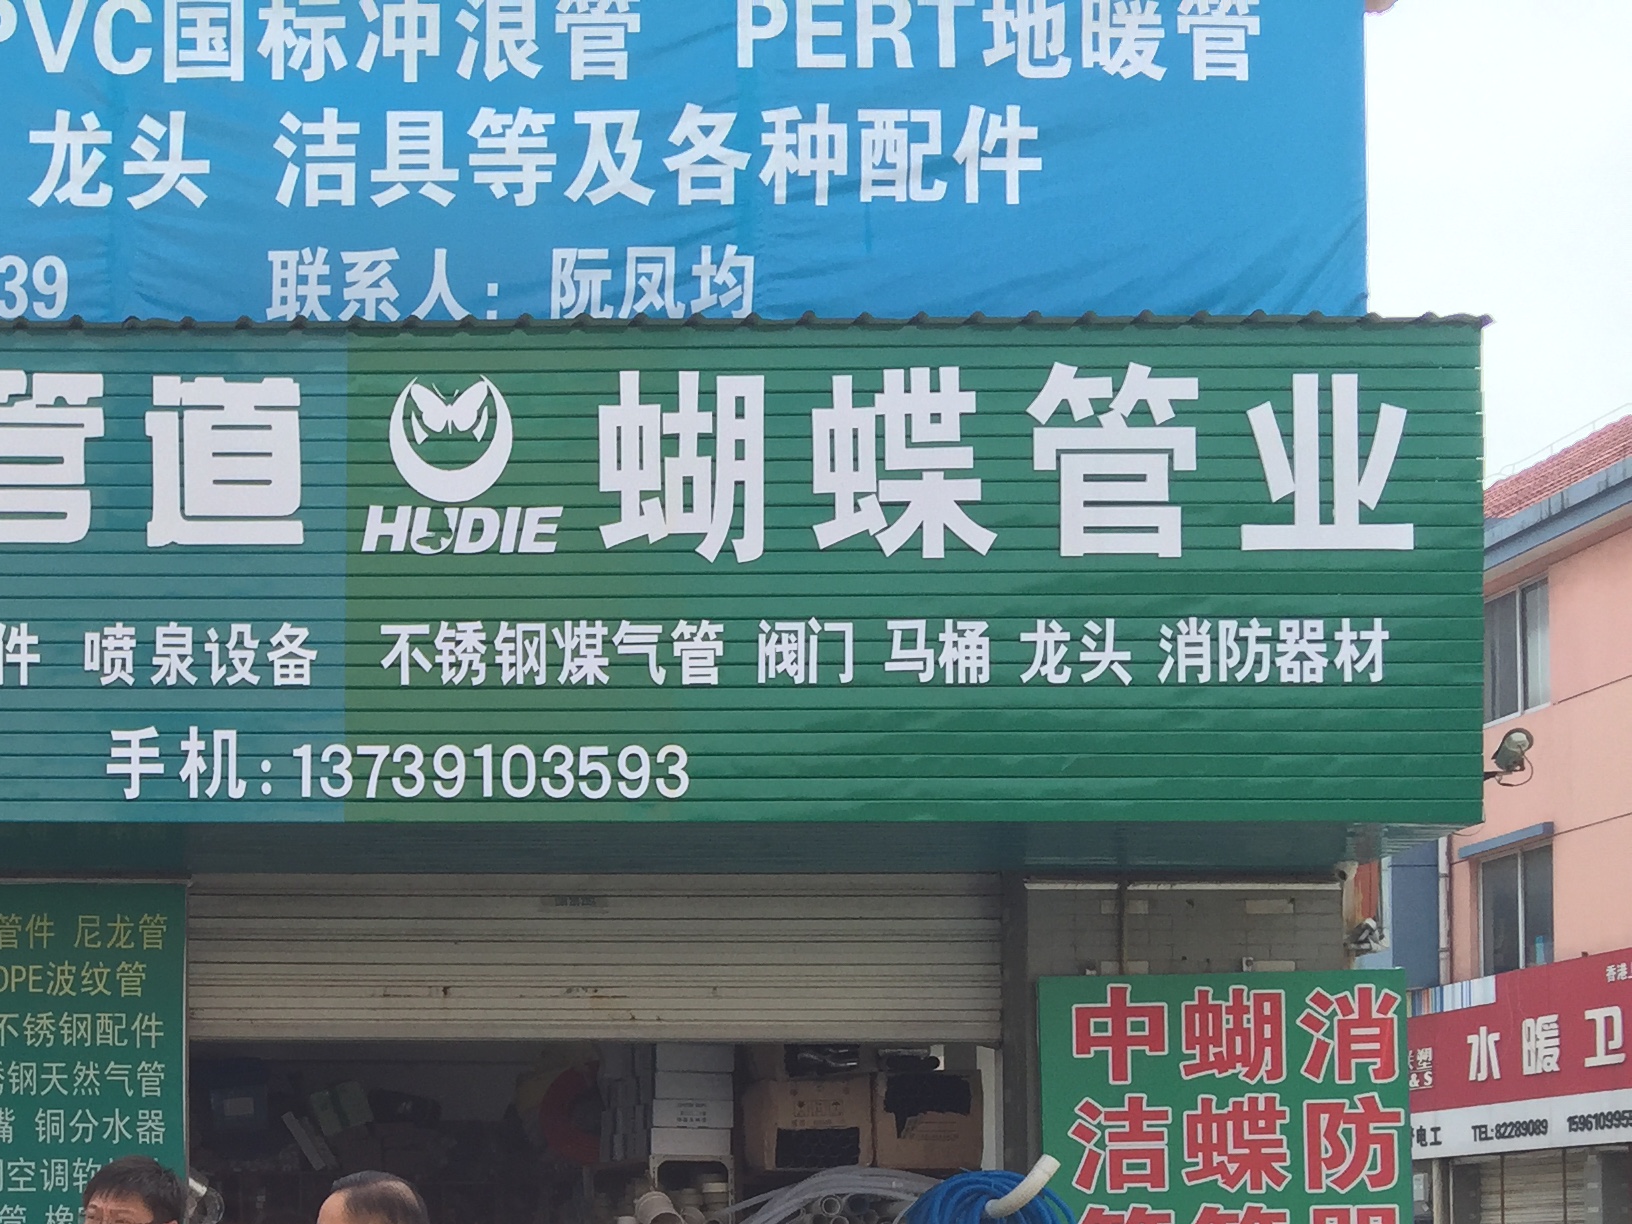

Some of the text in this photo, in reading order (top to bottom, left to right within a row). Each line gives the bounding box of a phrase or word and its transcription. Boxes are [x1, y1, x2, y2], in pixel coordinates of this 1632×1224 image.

[28, 110, 209, 209] 龙头
[273, 104, 1043, 207] 洁具等及各种配件
[550, 246, 756, 320] 阮凤均
[598, 362, 1414, 563] 蝴蝶管业
[85, 622, 317, 685] 喷泉设备
[381, 617, 1389, 685] 不锈钢煤气管 阀门 马桶 龙头 消防器材
[74, 913, 168, 951] 尼龙管
[35, 1108, 166, 1145] 铜分水器
